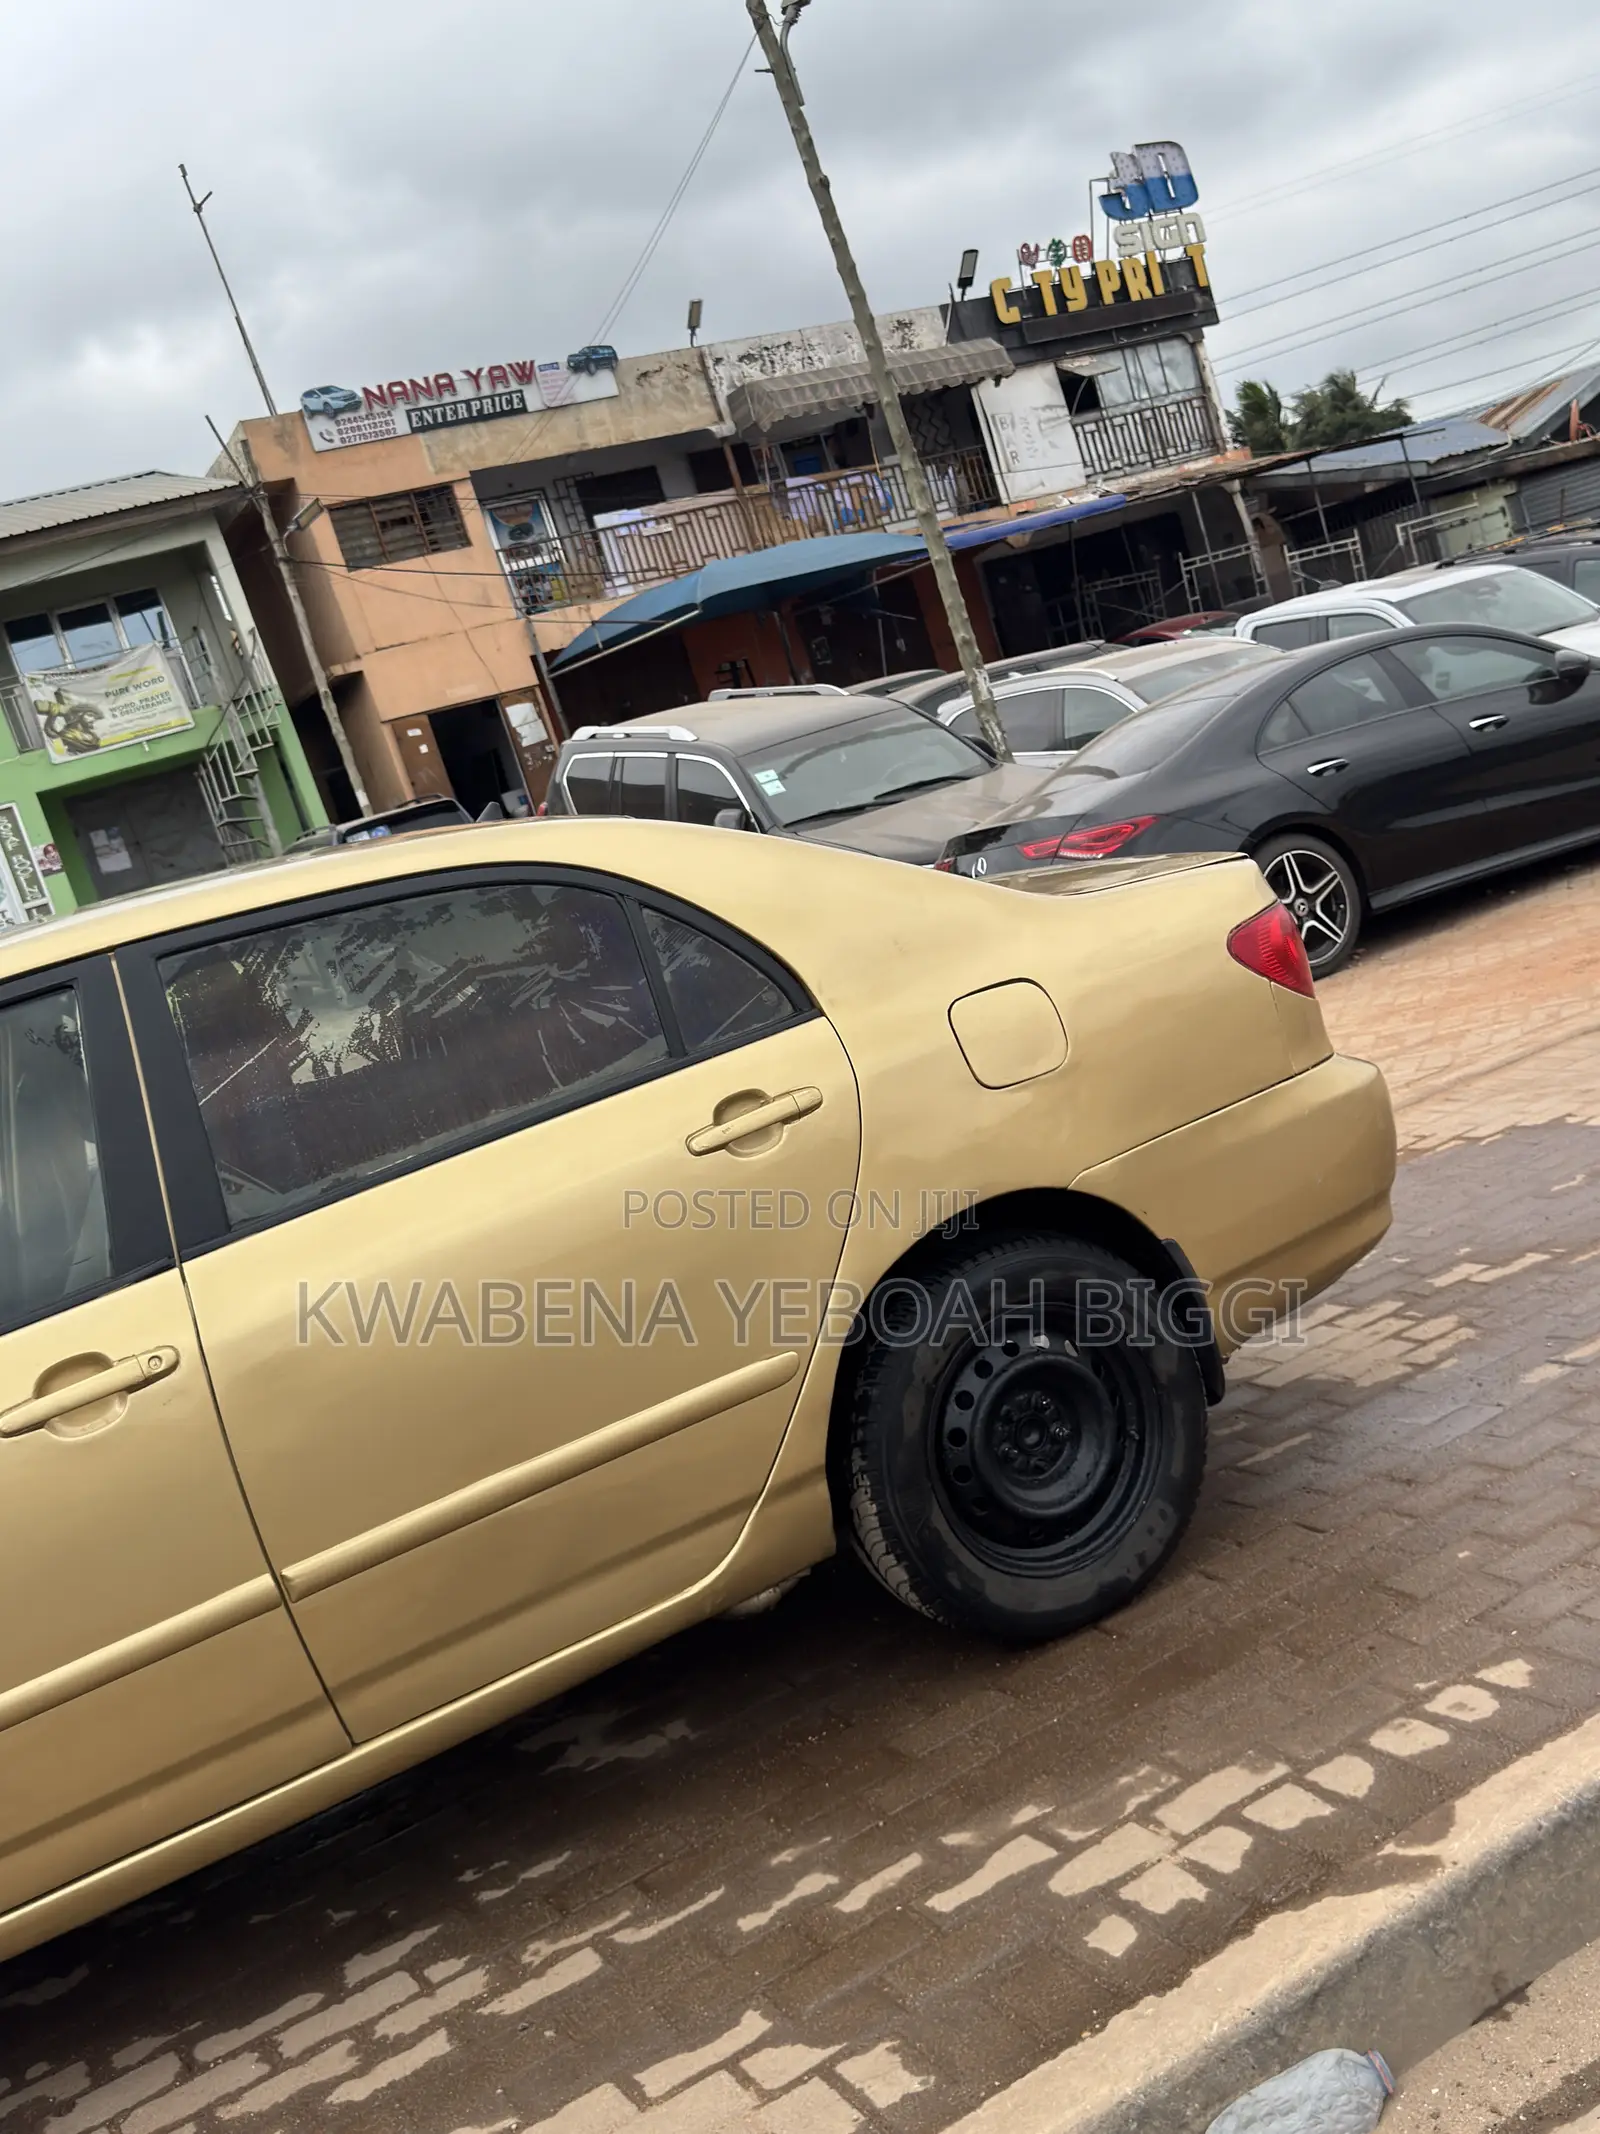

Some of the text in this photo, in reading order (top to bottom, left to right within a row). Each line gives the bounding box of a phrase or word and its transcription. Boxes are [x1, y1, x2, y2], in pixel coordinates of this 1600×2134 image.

[361, 373, 458, 411] NANA
[460, 360, 536, 393] YAW
[410, 392, 524, 428] ENTERPRICE
[104, 675, 166, 699] PURE WORD
[139, 690, 171, 704] PRAYER
